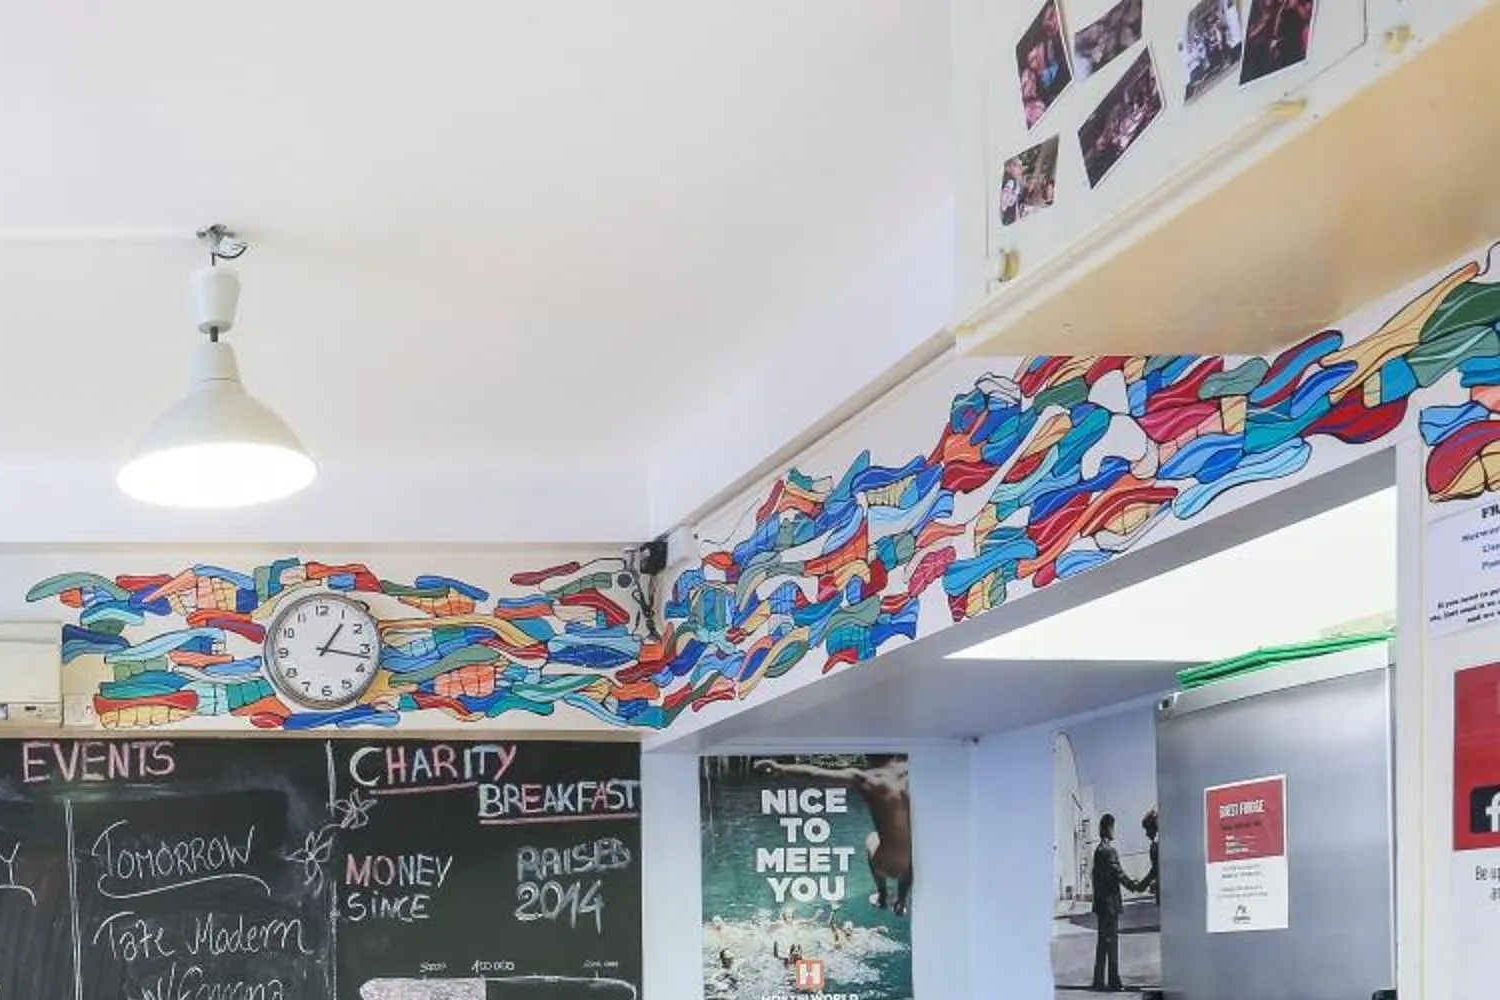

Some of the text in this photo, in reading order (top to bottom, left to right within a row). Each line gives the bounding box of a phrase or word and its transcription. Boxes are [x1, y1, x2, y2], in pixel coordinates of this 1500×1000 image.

[316, 605, 329, 616] 12
[284, 627, 295, 638] 10
[354, 623, 363, 634] 2
[279, 647, 289, 658] 9
[302, 681, 311, 692] 7
[322, 685, 332, 697] 6
[22, 741, 176, 783] EVENTS
[349, 744, 516, 787] CHARITY
[479, 779, 640, 817] BREAKFAST
[761, 788, 848, 814] NICE
[780, 817, 830, 843] TO
[345, 853, 453, 889] MONEY
[517, 837, 631, 881] RAISED
[756, 847, 855, 873] MEET
[768, 877, 844, 902] YOU
[514, 880, 603, 934] 2014
[94, 911, 316, 961] Tate Modern
